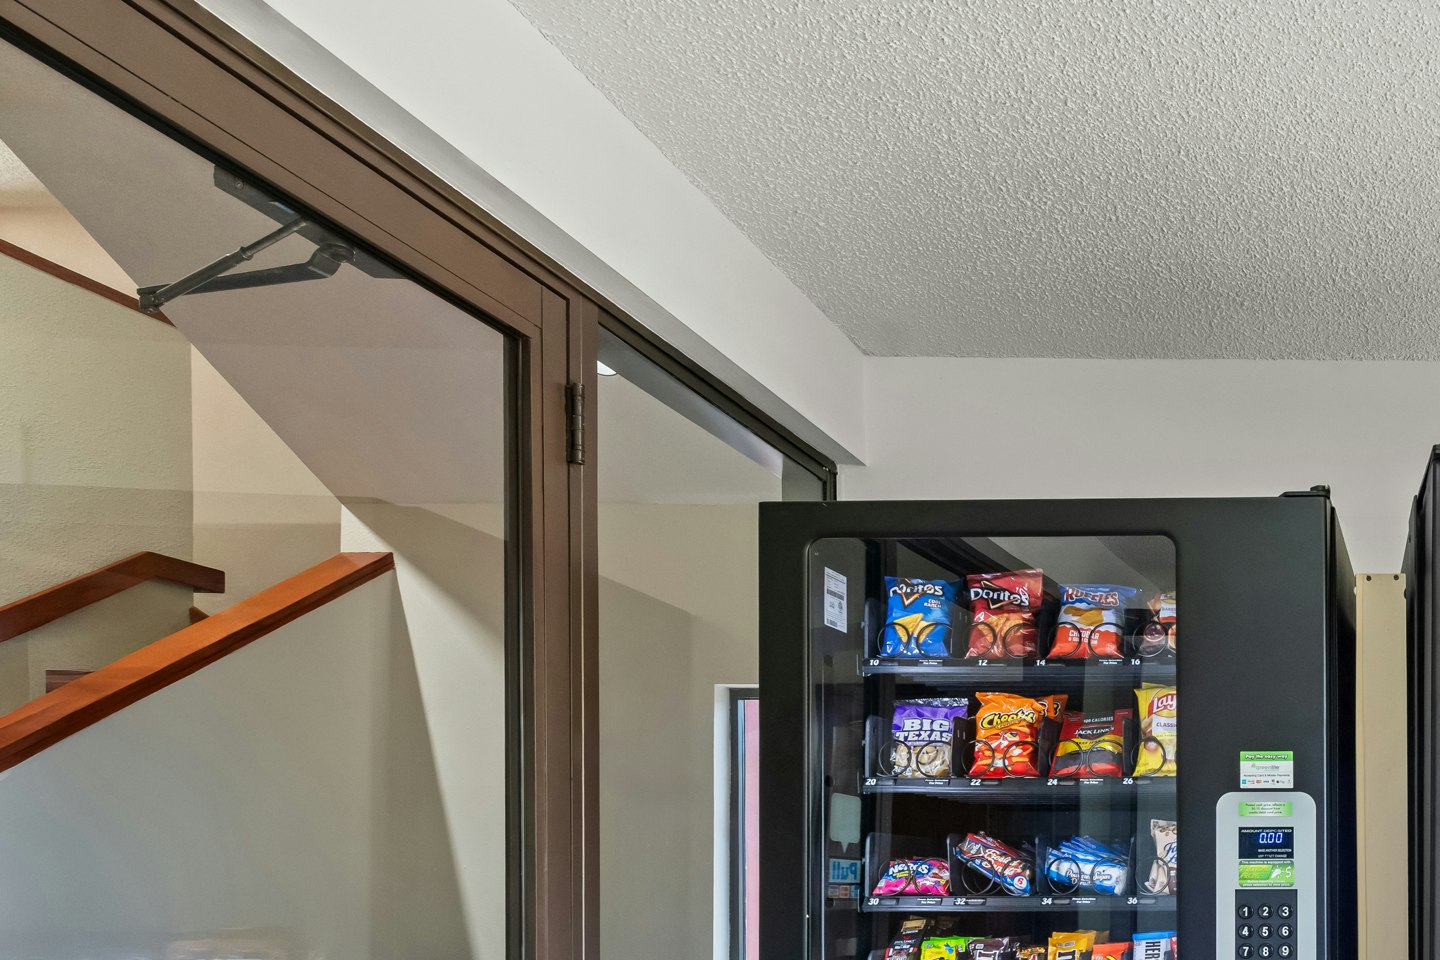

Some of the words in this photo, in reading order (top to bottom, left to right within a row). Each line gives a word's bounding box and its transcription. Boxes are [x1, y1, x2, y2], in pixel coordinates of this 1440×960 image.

[869, 659, 880, 667] 10
[978, 659, 989, 667] 12
[1036, 659, 1047, 667] 14
[1130, 658, 1141, 667] 16
[902, 718, 951, 732] BIG
[895, 731, 953, 742] TEXAS
[1074, 728, 1093, 736] JACK
[865, 778, 877, 786] 20
[970, 778, 982, 786] 22
[1047, 778, 1058, 786] 24
[868, 897, 880, 906] 30
[955, 897, 967, 906] 32
[1041, 897, 1053, 905] 34
[1127, 897, 1138, 905] 36
[1242, 906, 1249, 917] 1
[1262, 906, 1269, 917] 2
[1282, 906, 1289, 917] 3
[1242, 926, 1249, 936] 4
[1262, 926, 1269, 936] 5
[1282, 926, 1289, 936] 6
[1242, 946, 1249, 957] 7
[1262, 946, 1269, 957] 8
[1282, 946, 1289, 957] 9
